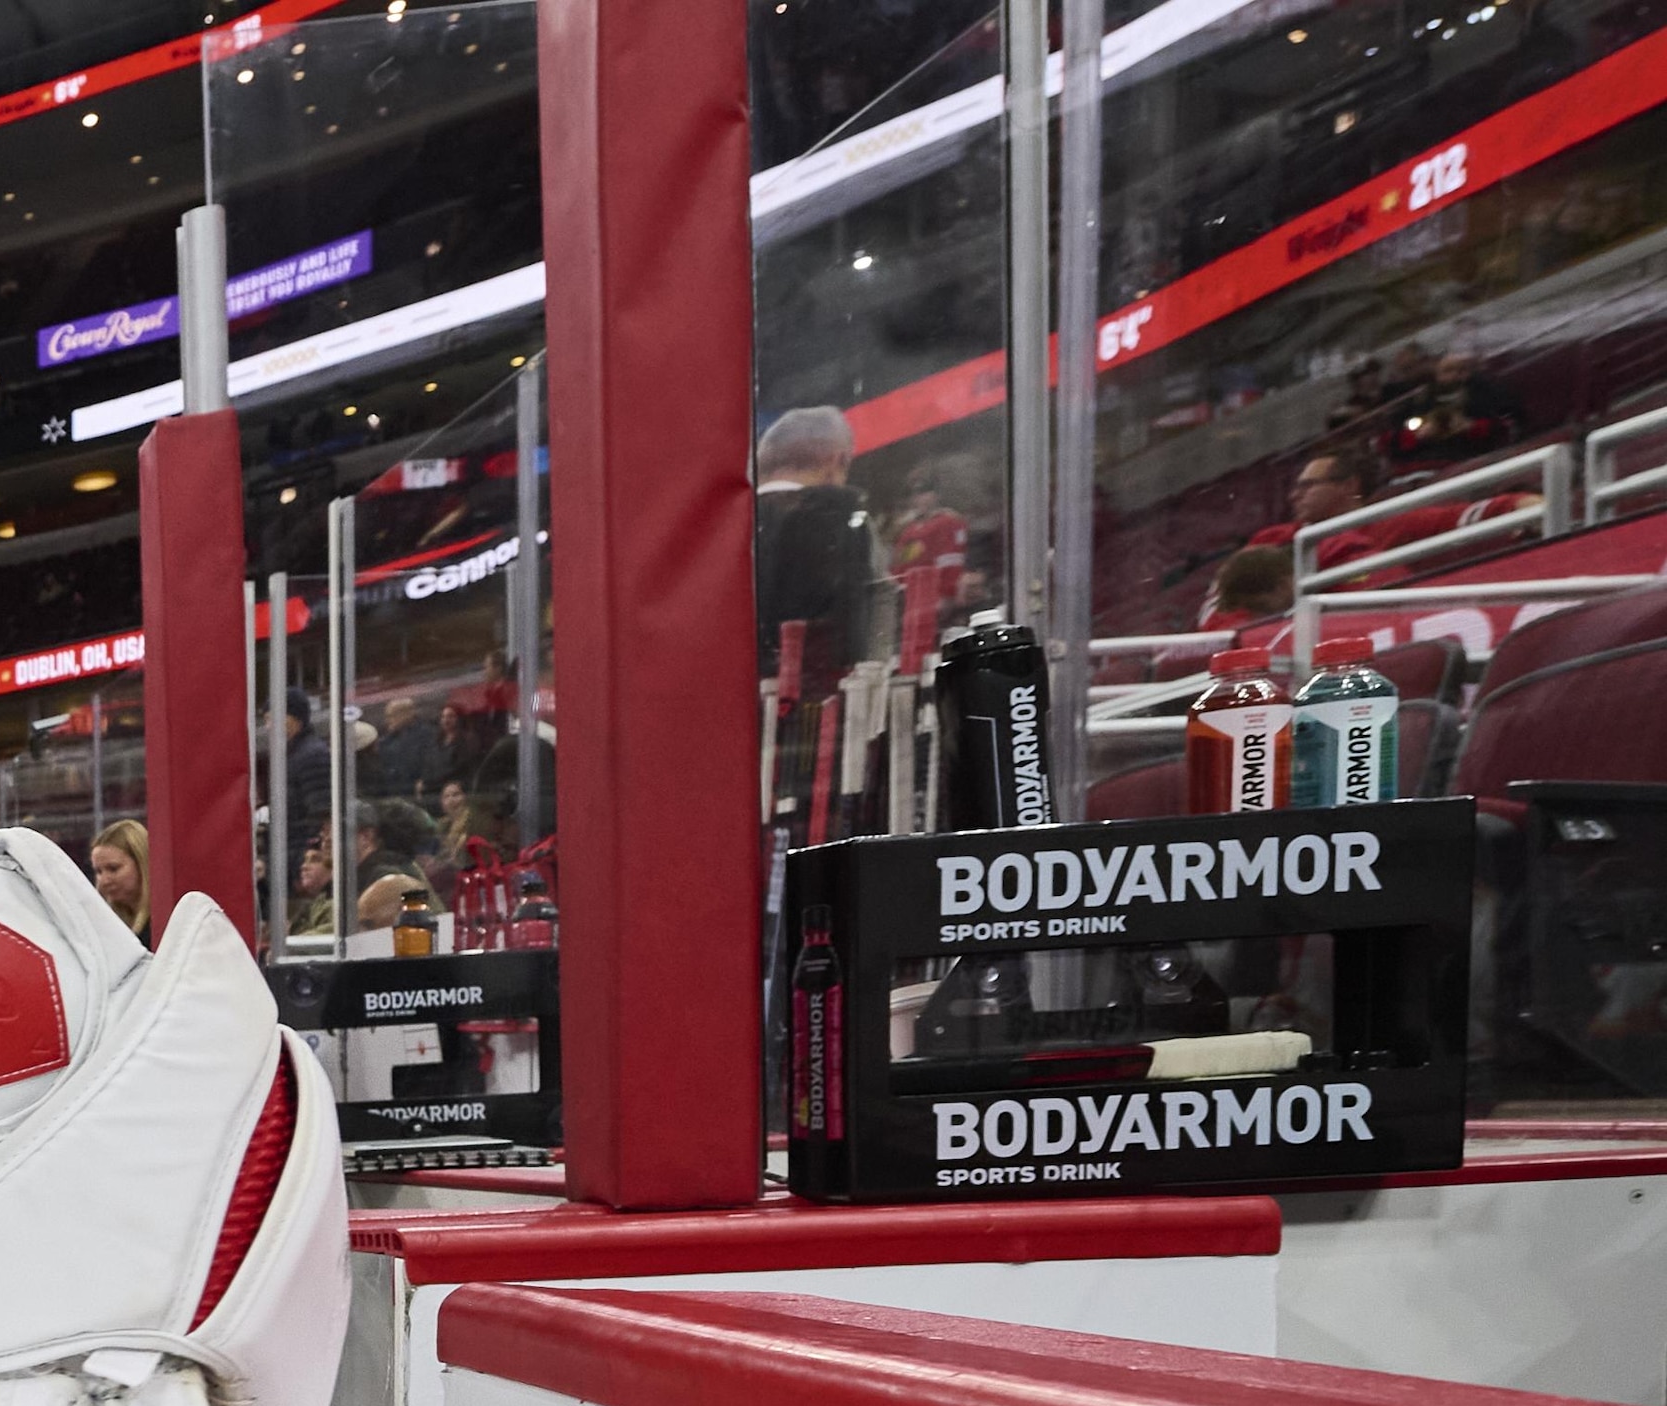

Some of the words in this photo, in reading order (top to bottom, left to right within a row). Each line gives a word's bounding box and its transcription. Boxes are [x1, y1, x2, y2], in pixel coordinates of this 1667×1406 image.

[1408, 142, 1468, 212] 212
[227, 263, 298, 298] ENEROUSLY
[15, 648, 81, 686] DUBLIN,
[81, 642, 113, 670] OH,
[1009, 683, 1045, 826] ODYARMOR
[1347, 724, 1373, 806] ARMOR
[936, 830, 1383, 916] BODYARMOR
[939, 920, 1041, 943] SPORTS
[1047, 914, 1128, 938] DRINK
[364, 985, 485, 1012] BODYARMOR
[809, 992, 825, 1131] BODYARMOR
[932, 1082, 1375, 1161] BODYARMOR
[936, 1165, 1037, 1187] SPORTS
[1042, 1161, 1123, 1182] DRINK
